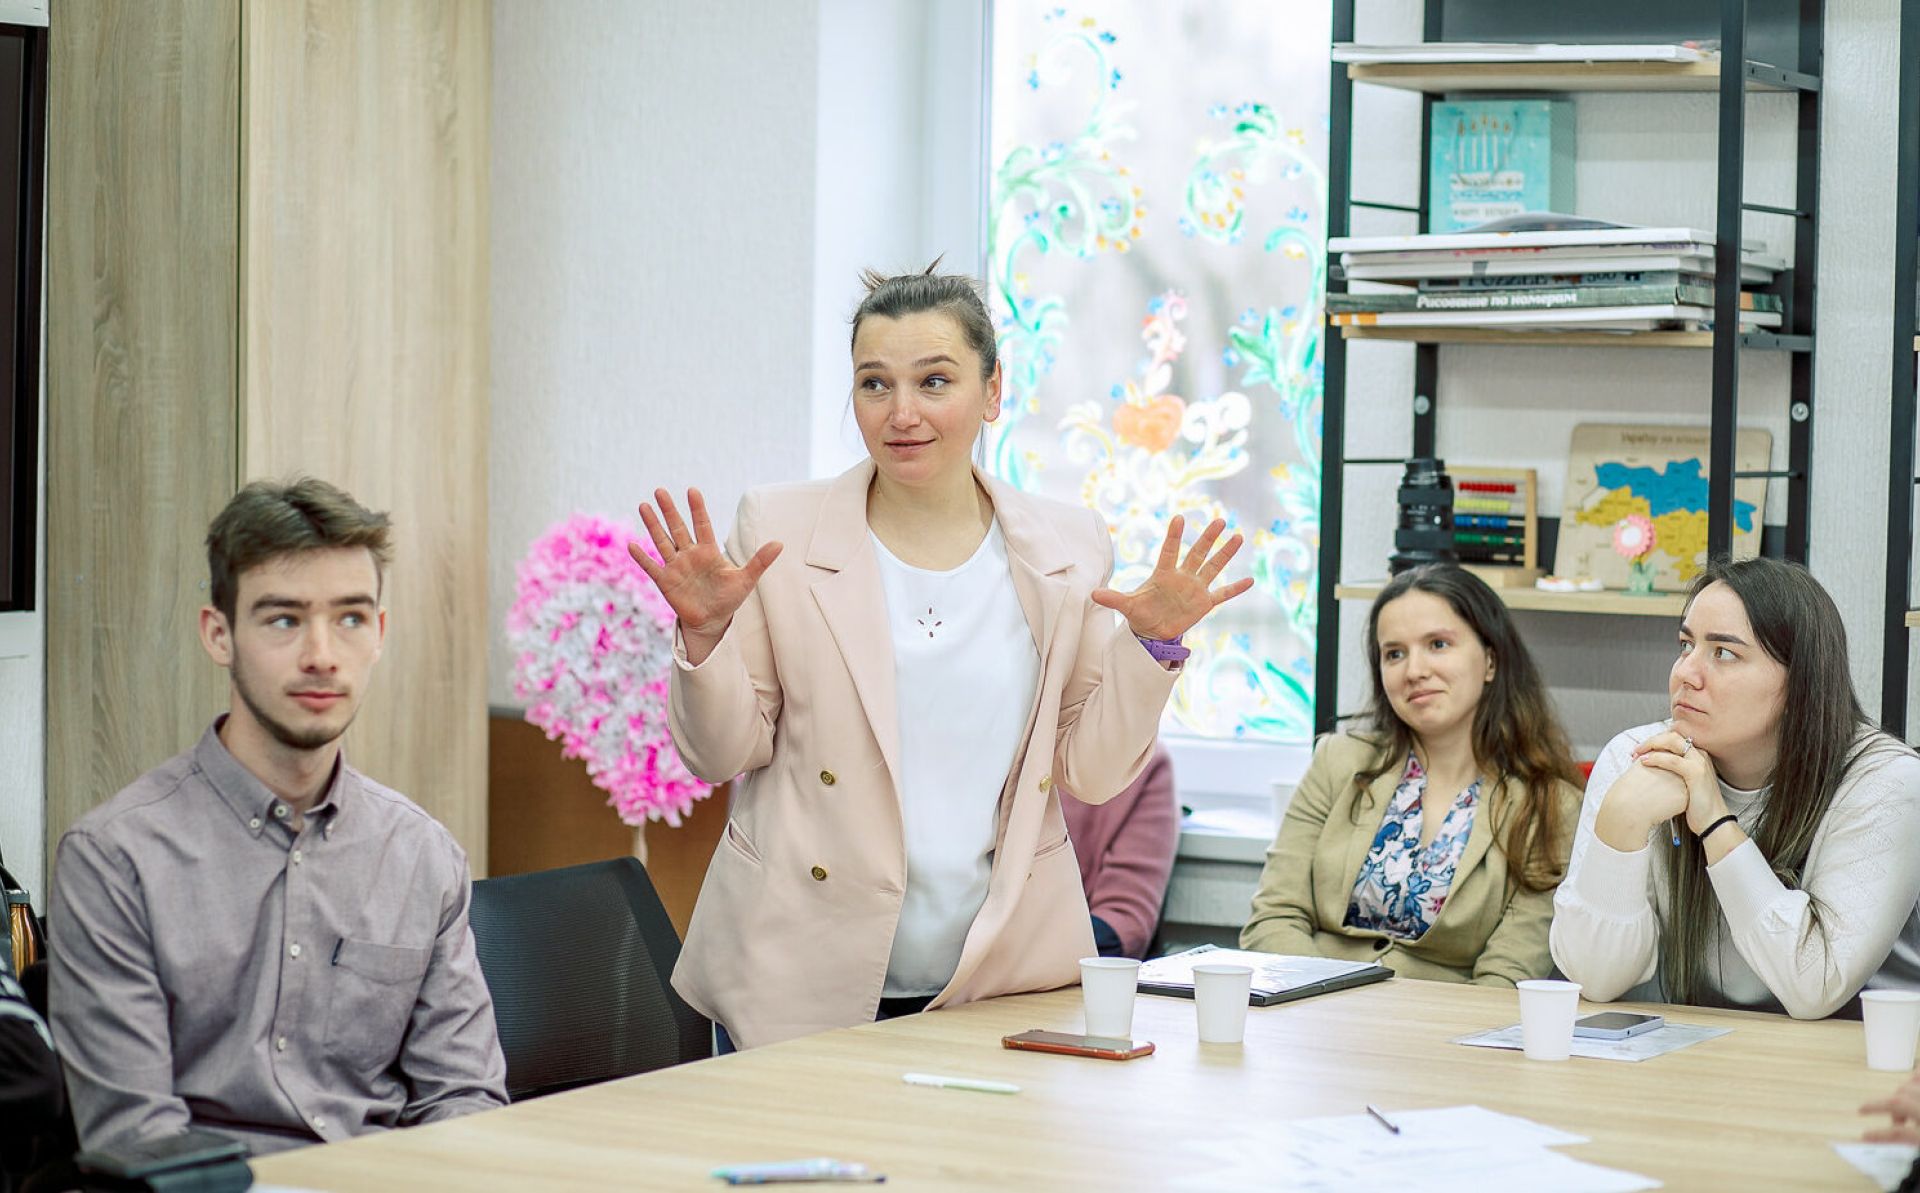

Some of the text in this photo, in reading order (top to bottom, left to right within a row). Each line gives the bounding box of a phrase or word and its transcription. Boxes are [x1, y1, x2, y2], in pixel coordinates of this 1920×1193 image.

[1416, 292, 1578, 309] Рисование по номерам
